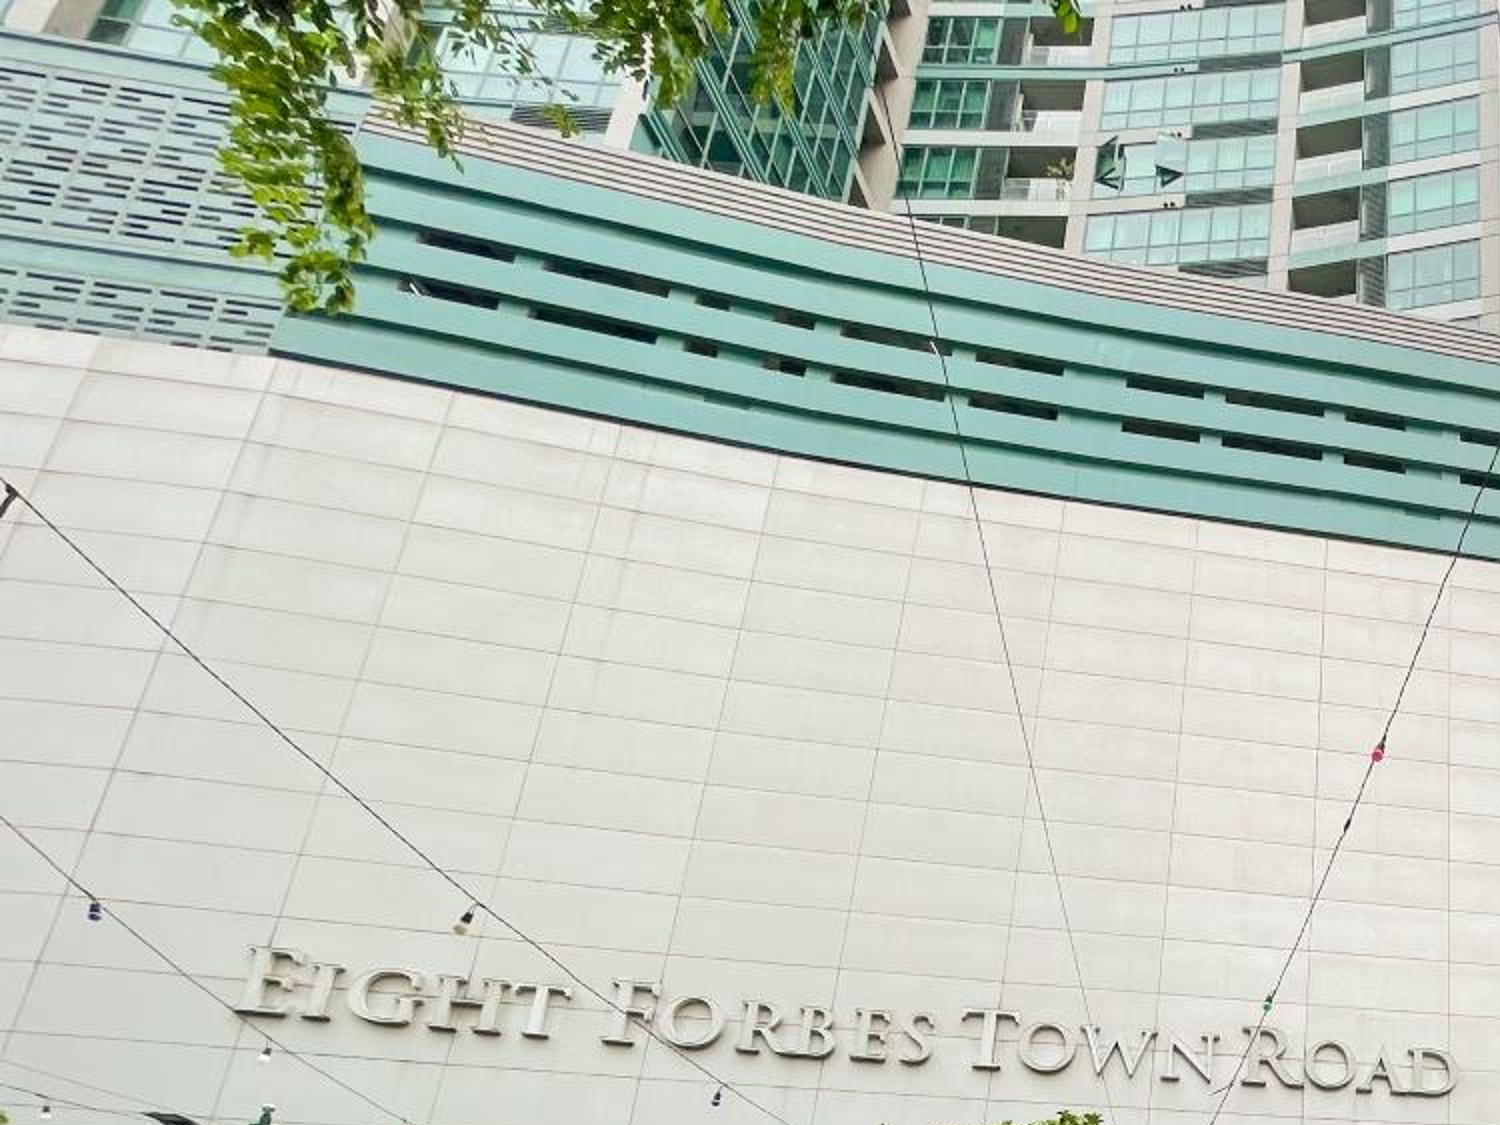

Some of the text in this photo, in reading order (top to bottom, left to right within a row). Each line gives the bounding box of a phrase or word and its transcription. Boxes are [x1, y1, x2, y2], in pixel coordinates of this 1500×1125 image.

[236, 945, 1458, 1098] EIGHT FORBES TOWN ROAD
